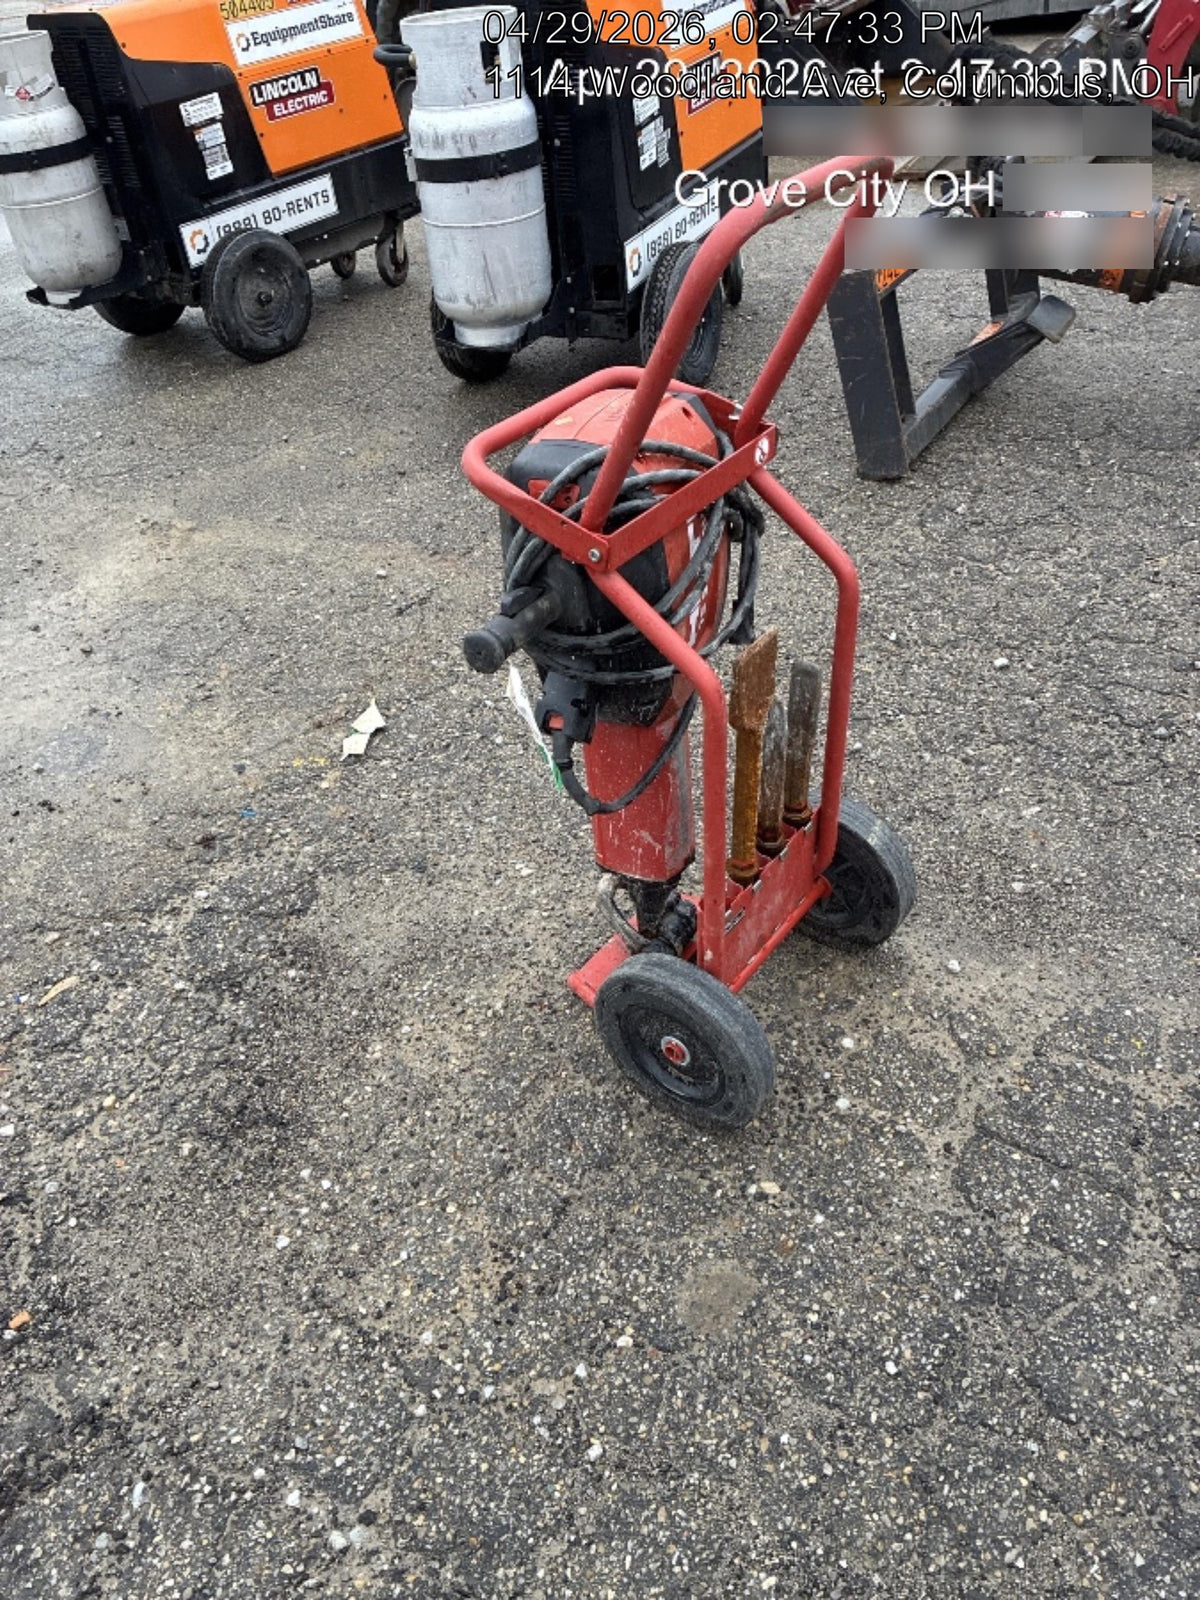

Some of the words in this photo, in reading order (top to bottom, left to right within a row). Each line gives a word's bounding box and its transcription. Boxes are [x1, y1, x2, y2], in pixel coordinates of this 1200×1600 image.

[251, 12, 355, 47] EquipmentShare
[253, 70, 318, 104] LINCOLN
[273, 90, 328, 117] ELECTRIC
[262, 189, 330, 225] 80-RENTS
